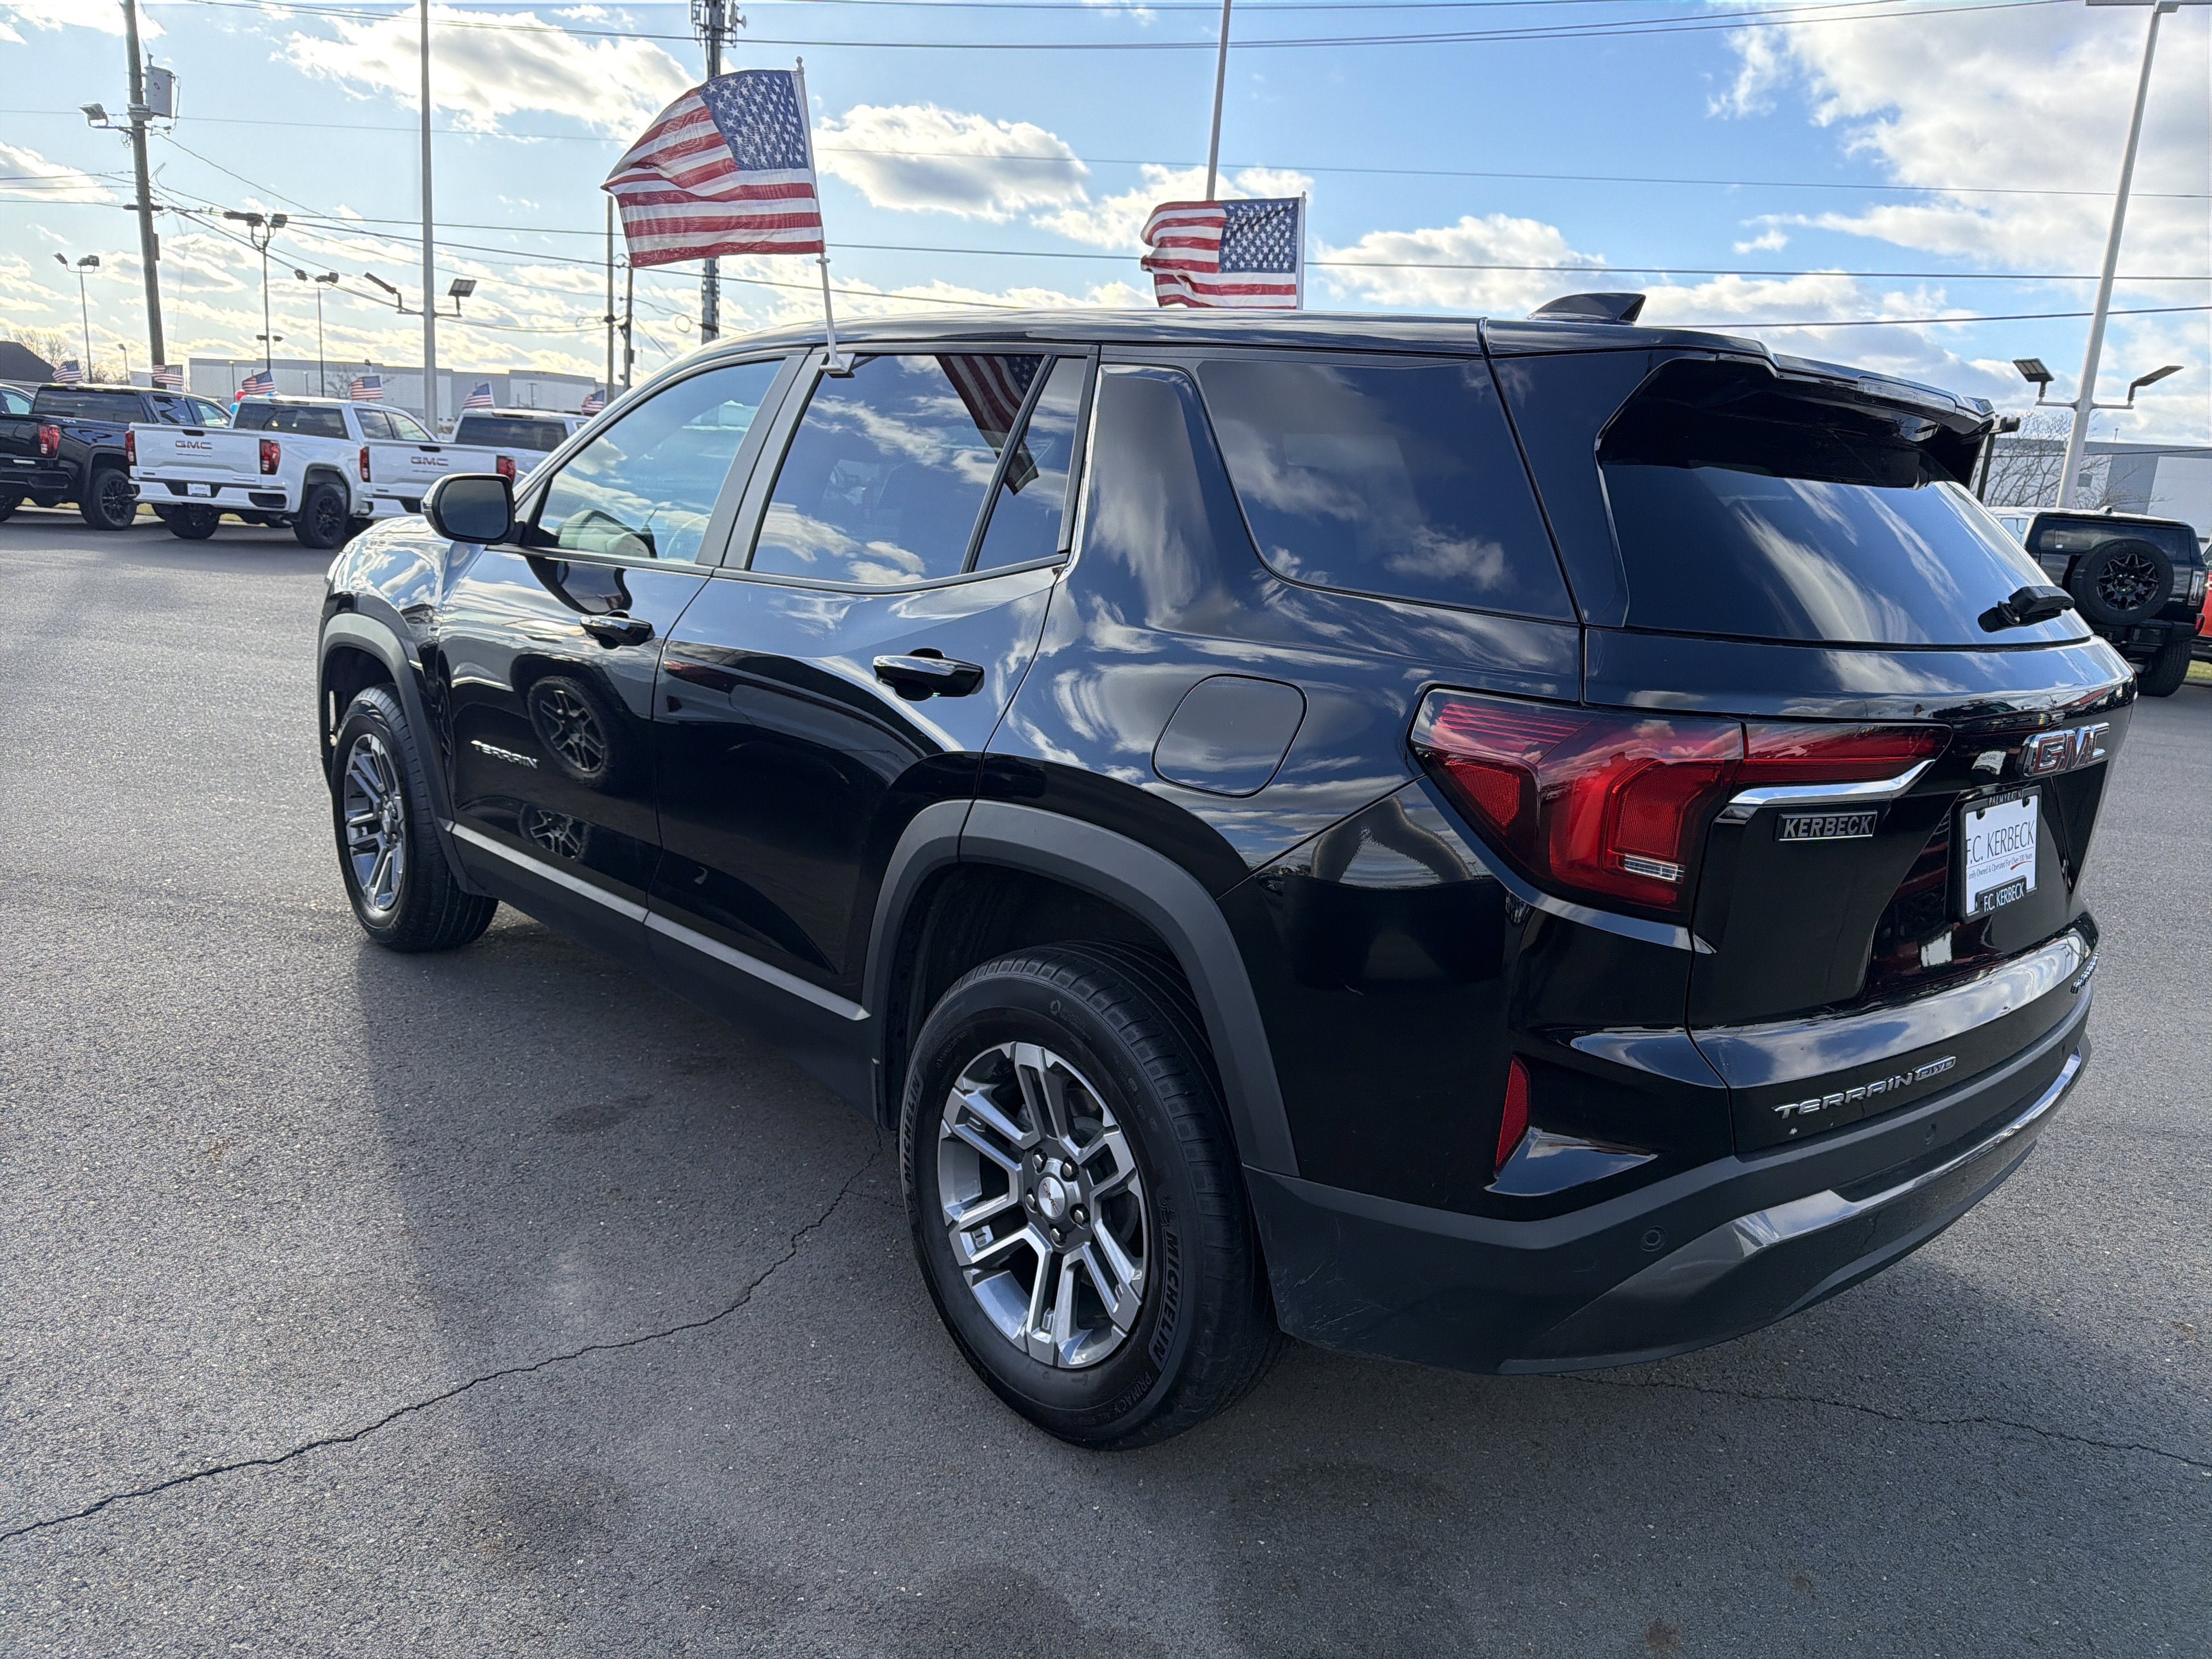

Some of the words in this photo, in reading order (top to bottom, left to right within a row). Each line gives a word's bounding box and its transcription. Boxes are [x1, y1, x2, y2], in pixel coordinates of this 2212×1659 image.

[175, 440, 212, 450] GMC
[411, 456, 449, 466] GMC
[471, 740, 539, 769] TERRAIN
[2022, 722, 2110, 777] GMC
[1784, 816, 1872, 838] KERBECK
[1987, 820, 2034, 859] KERBECK
[1976, 865, 1988, 877] Owned
[1992, 860, 2006, 872] Operated
[1984, 893, 1995, 912] F.C.
[1996, 881, 2024, 908] KERBECK
[1771, 1072, 1913, 1119] TERRAIN
[904, 1074, 920, 1184] MICHELIN
[1043, 1181, 1060, 1215] GMC
[1152, 1231, 1180, 1362] MICHELIN
[1114, 1371, 1153, 1414] PRIMACY
